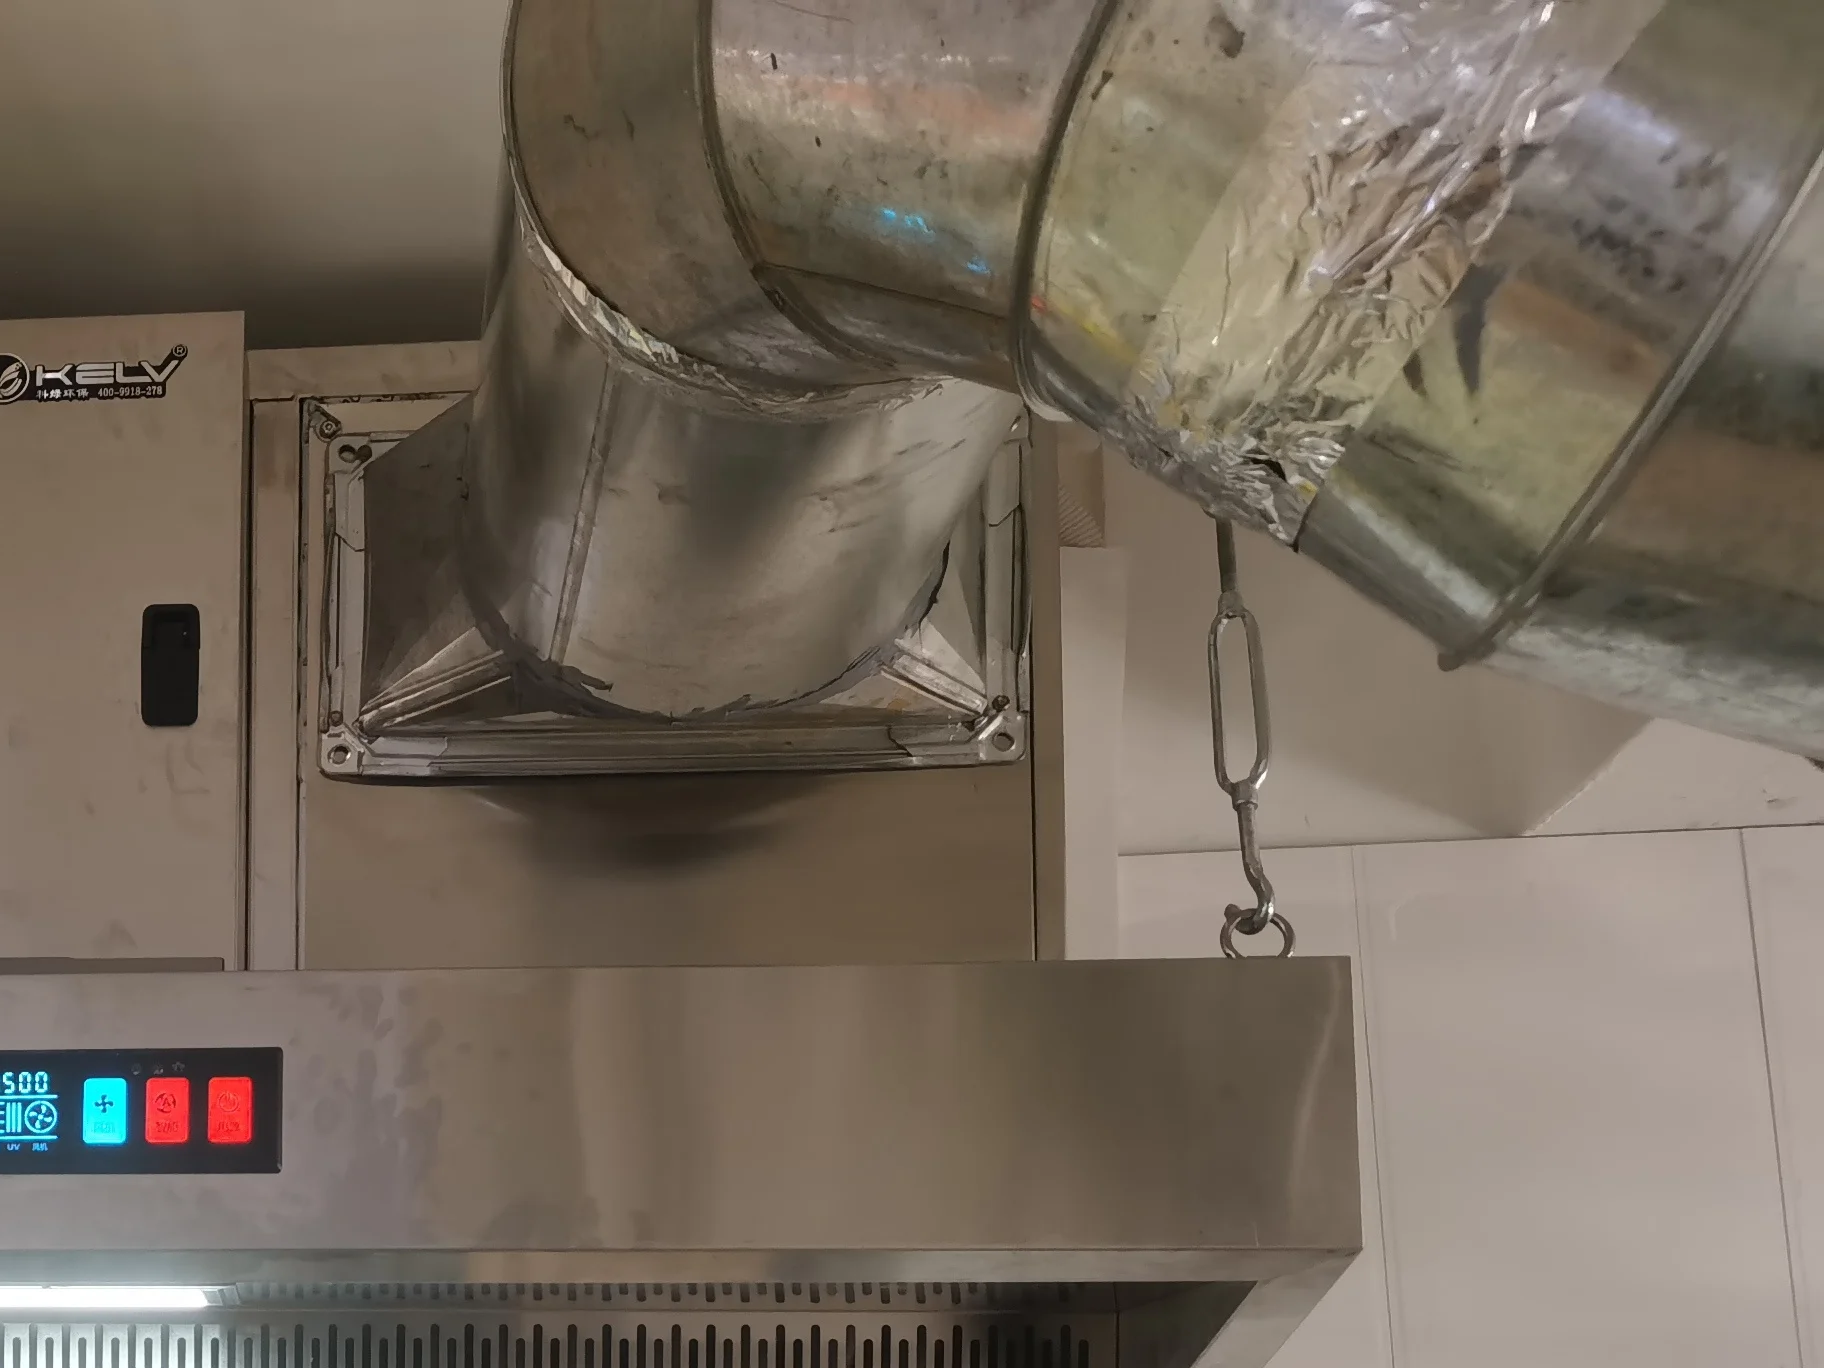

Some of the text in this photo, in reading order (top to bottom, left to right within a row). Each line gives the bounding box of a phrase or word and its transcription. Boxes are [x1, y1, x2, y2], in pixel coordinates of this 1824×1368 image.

[35, 360, 179, 387] KELV
[97, 385, 164, 398] 400-9918-278
[7, 1143, 20, 1151] UV
[32, 1142, 48, 1151] 风机
